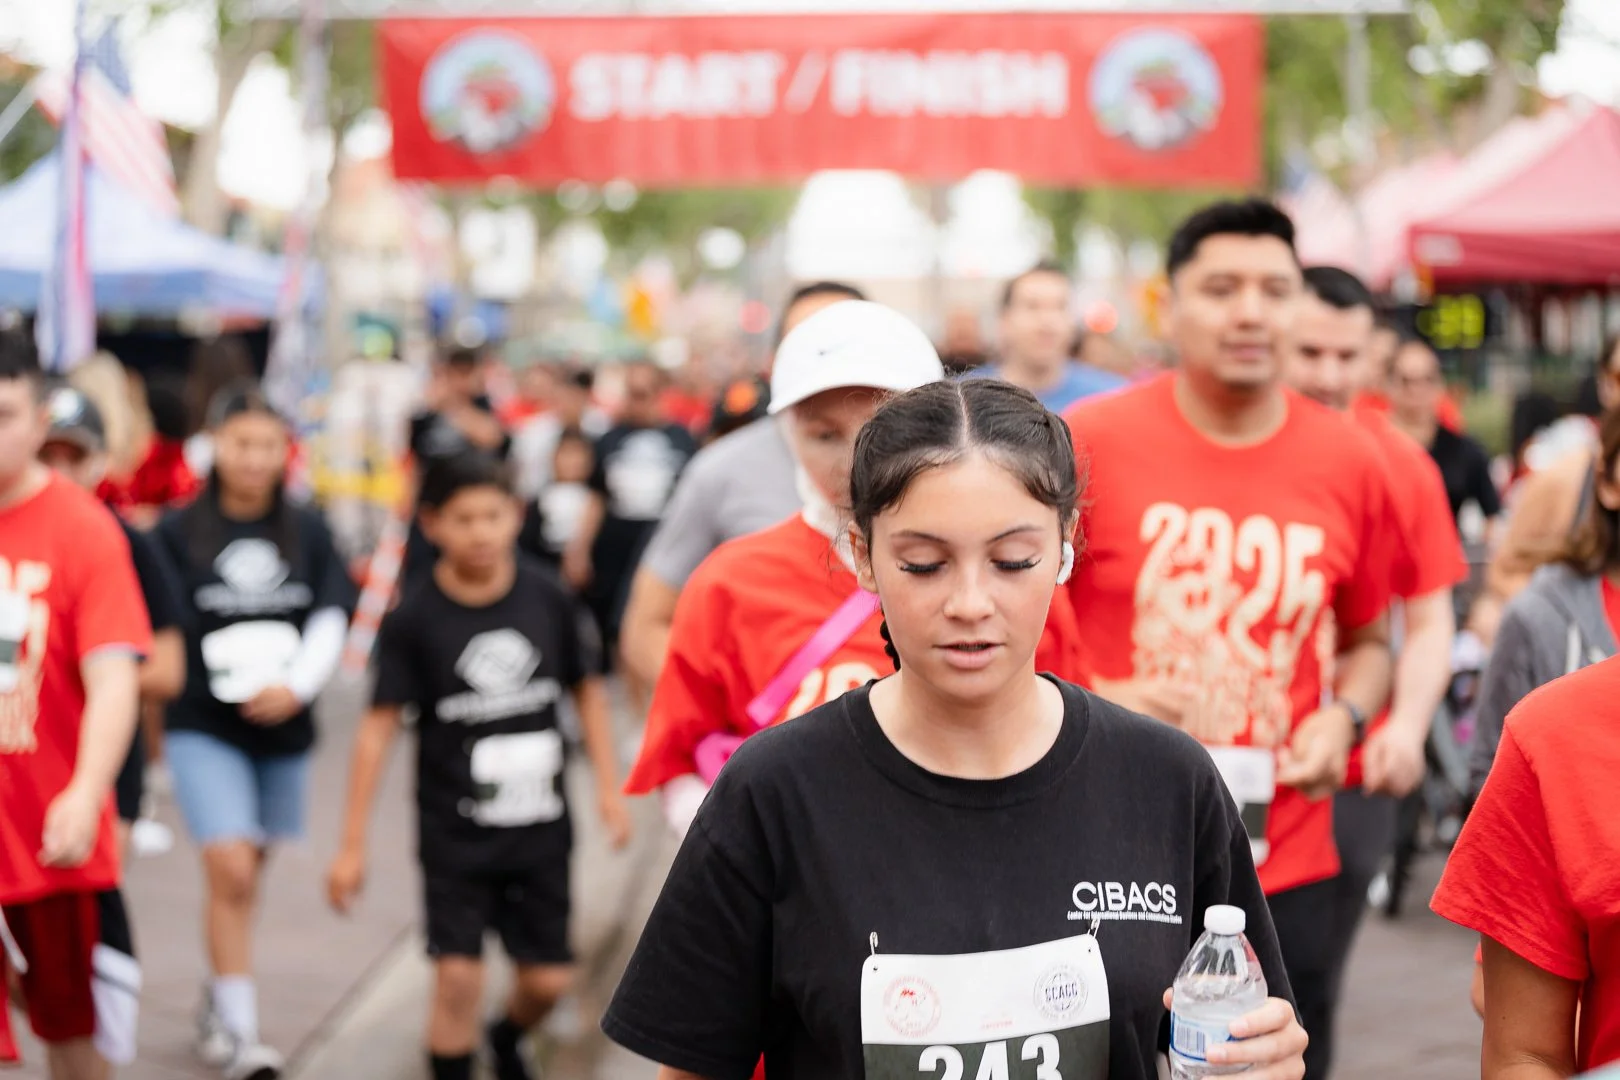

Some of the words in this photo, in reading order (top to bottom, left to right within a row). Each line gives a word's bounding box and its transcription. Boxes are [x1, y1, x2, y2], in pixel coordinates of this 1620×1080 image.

[568, 50, 783, 121] START
[830, 48, 1069, 117] FINISH
[1135, 501, 1325, 670] 2025
[1072, 881, 1177, 915] CIBACS
